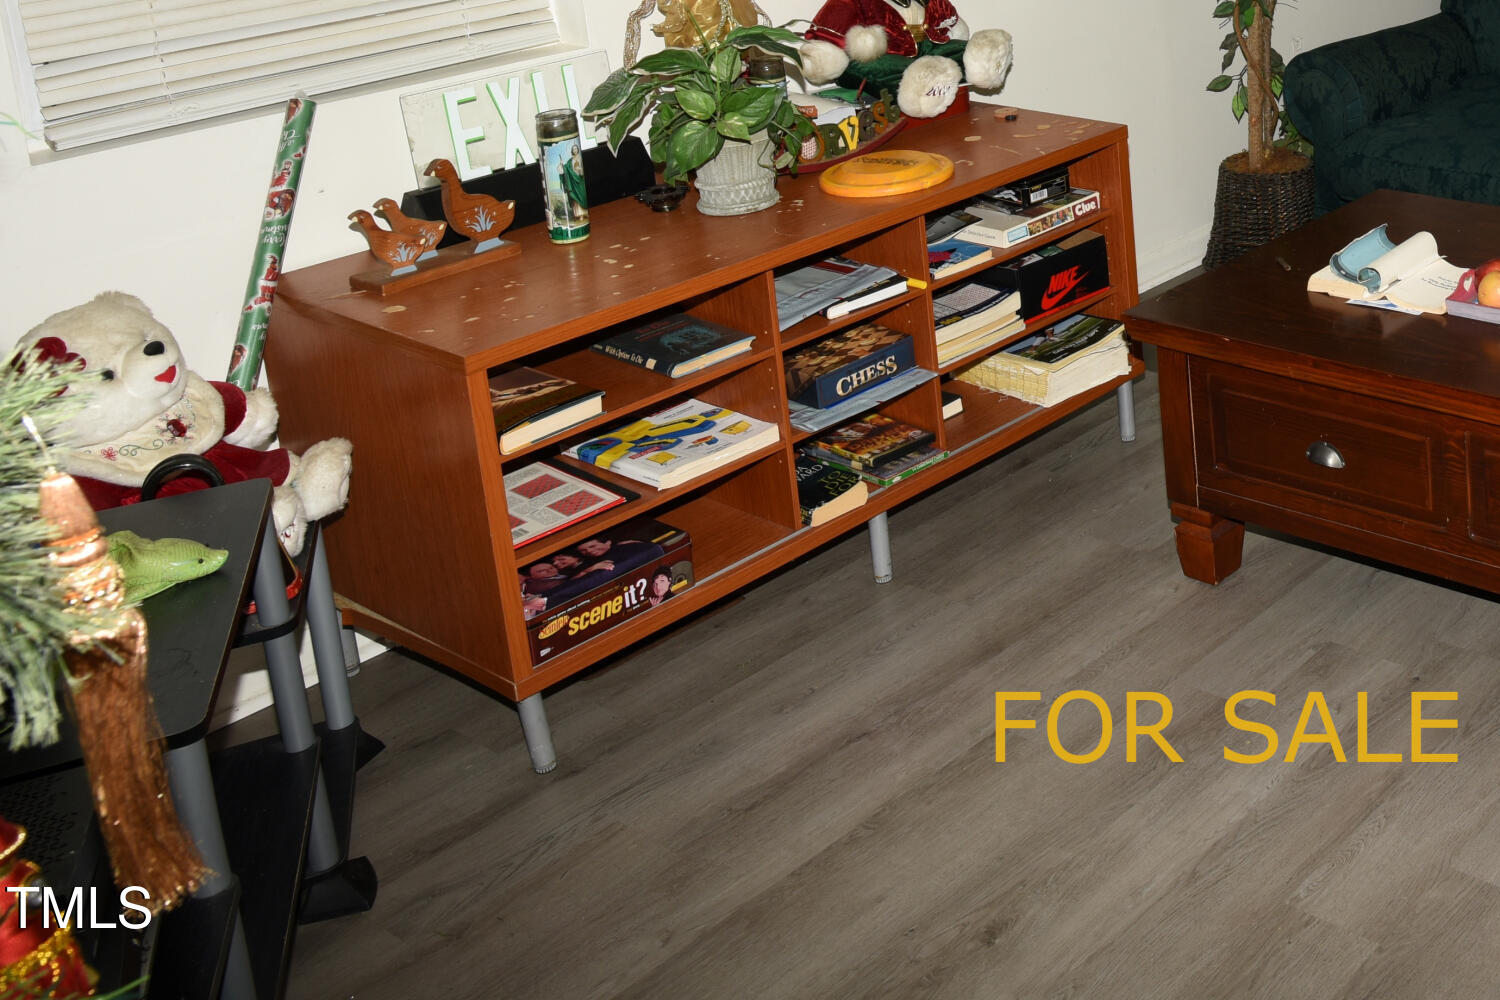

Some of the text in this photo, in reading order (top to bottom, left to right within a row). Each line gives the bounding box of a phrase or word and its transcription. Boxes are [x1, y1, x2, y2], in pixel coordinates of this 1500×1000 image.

[1074, 200, 1097, 216] Clue
[1047, 264, 1081, 295] NIKE
[836, 354, 898, 397] CHESS
[819, 470, 841, 483] TO
[823, 472, 851, 490] DIE
[567, 594, 623, 637] scene
[623, 577, 648, 609] it?
